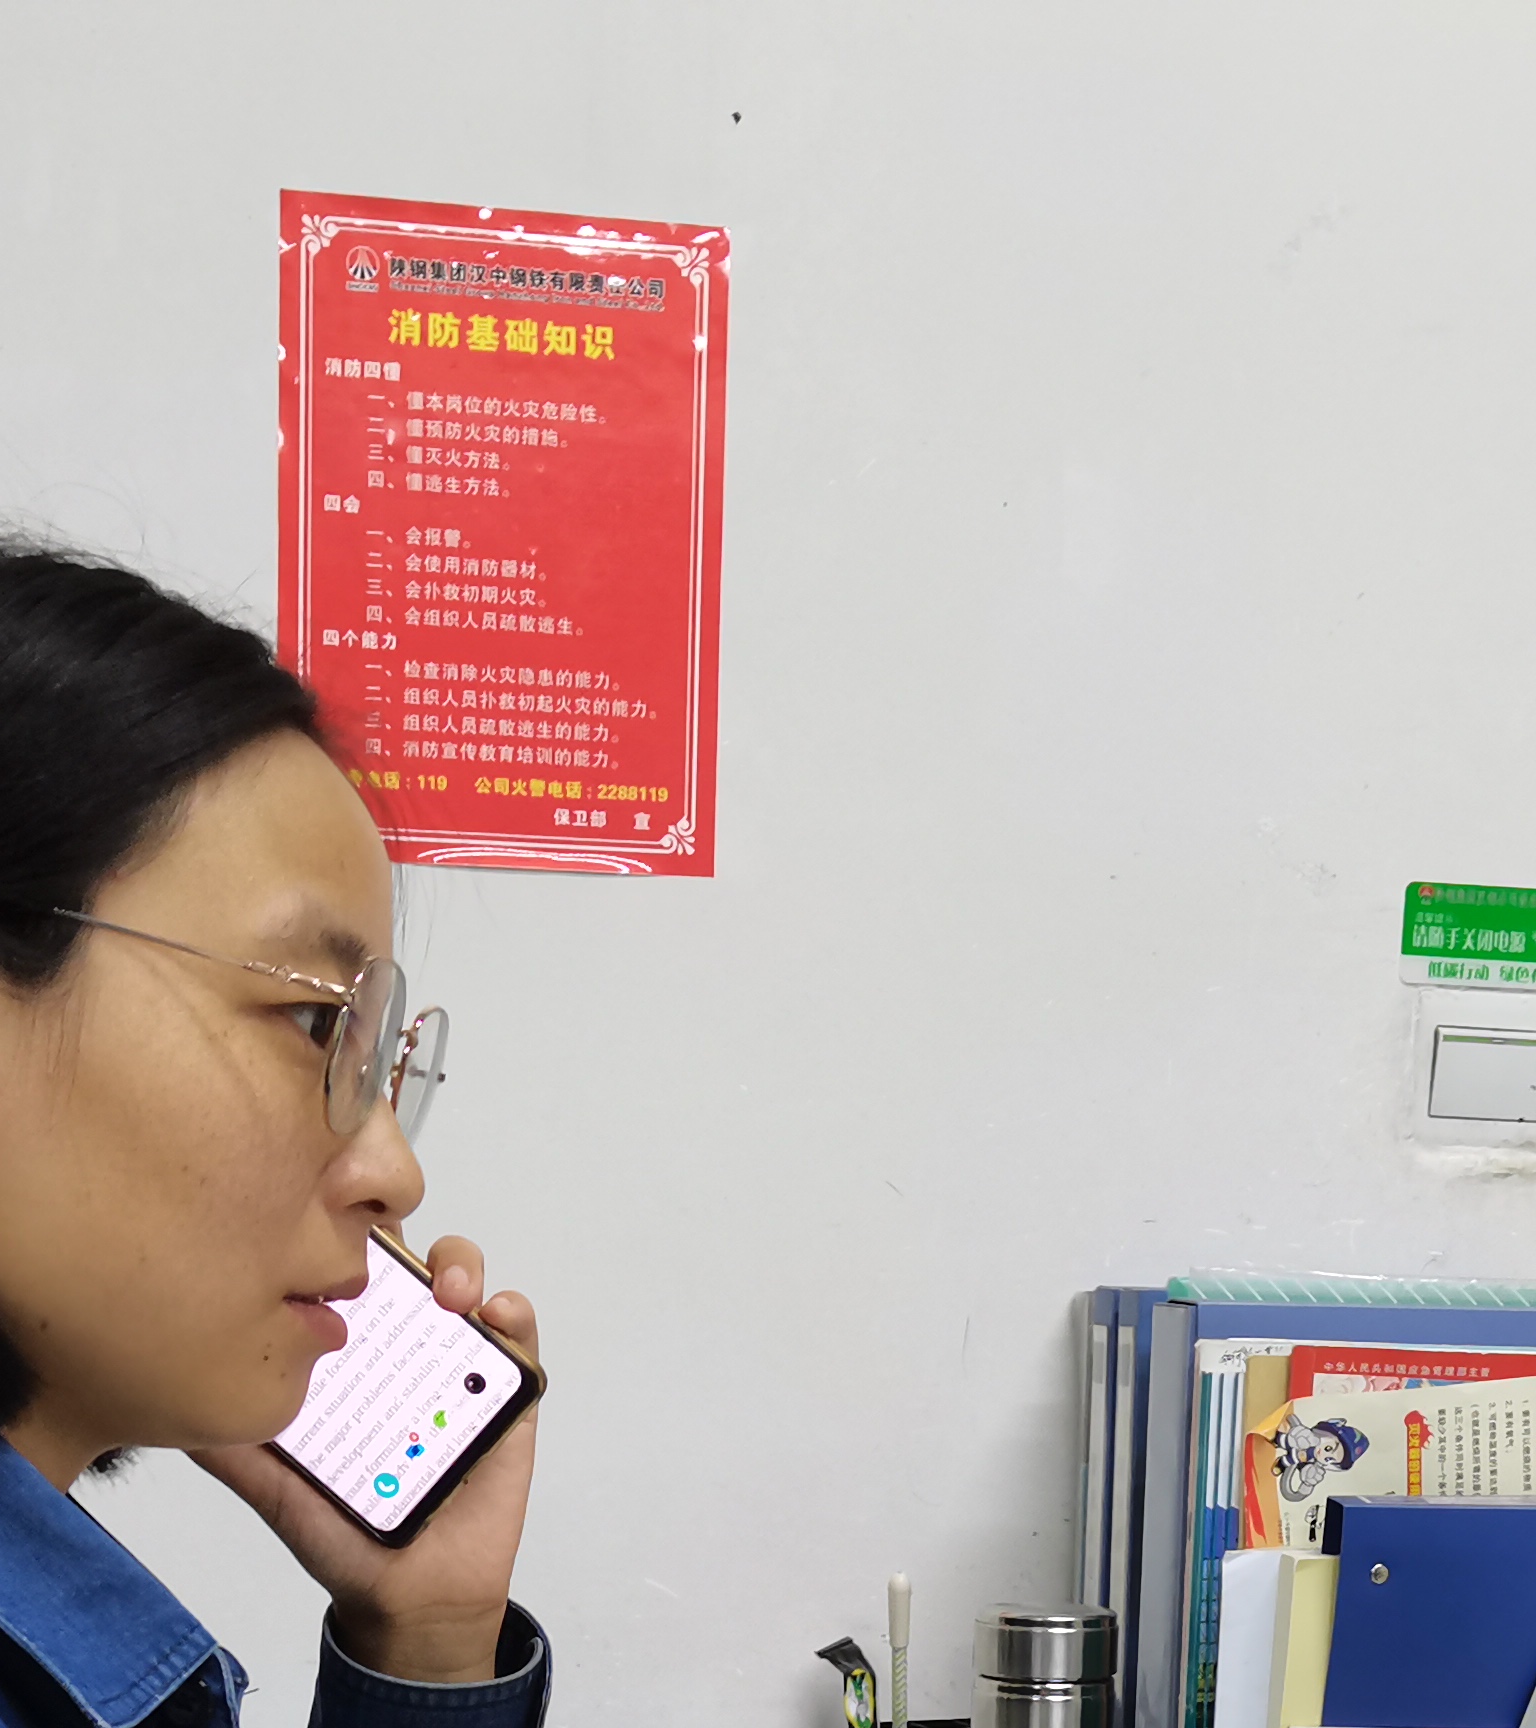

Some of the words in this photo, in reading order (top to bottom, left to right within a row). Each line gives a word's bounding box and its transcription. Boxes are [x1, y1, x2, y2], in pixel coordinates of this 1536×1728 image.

[388, 308, 615, 361] 消防基础知识
[324, 494, 361, 513] 四会
[322, 629, 398, 651] 四个能力
[554, 810, 607, 829] 保卫部
[323, 1330, 369, 1380] focusing
[363, 1315, 381, 1334] on
[375, 1294, 397, 1317] the
[320, 1367, 367, 1419] situation
[360, 1346, 385, 1372] and
[321, 1419, 355, 1456] major
[348, 1368, 398, 1423] problems
[420, 1320, 438, 1339] its
[323, 1417, 387, 1489] development
[379, 1396, 404, 1422] and
